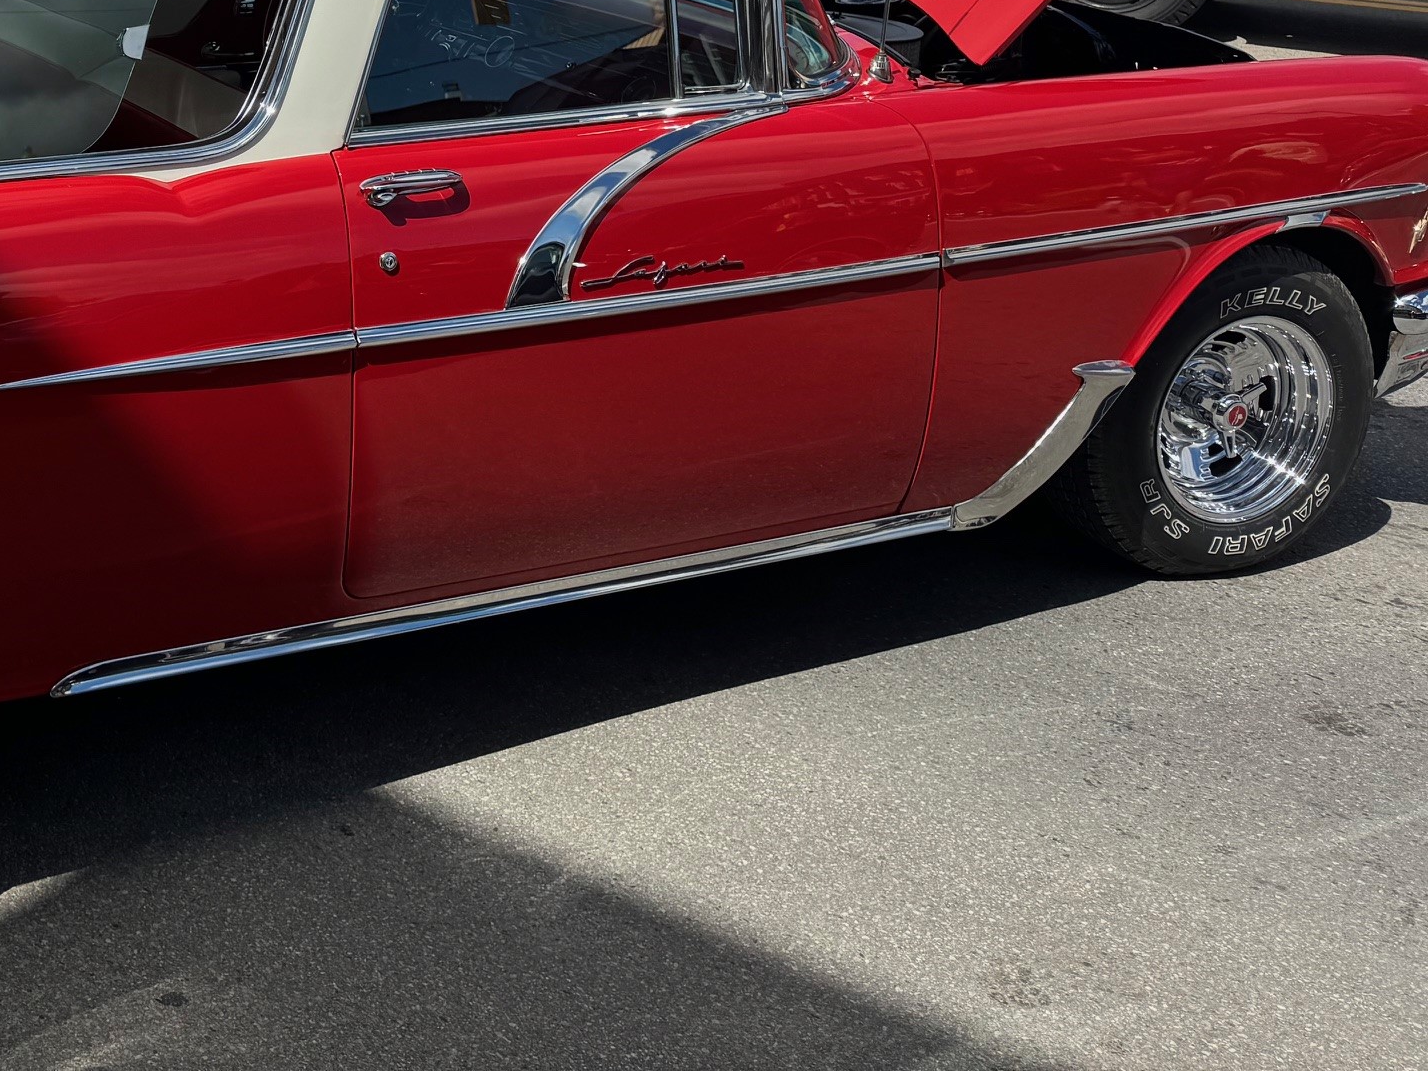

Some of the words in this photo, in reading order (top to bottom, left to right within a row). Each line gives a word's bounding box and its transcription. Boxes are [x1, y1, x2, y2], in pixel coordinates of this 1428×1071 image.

[1219, 286, 1327, 319] KELLY
[1139, 478, 1190, 540] SJR
[1208, 474, 1331, 556] SAFARI
